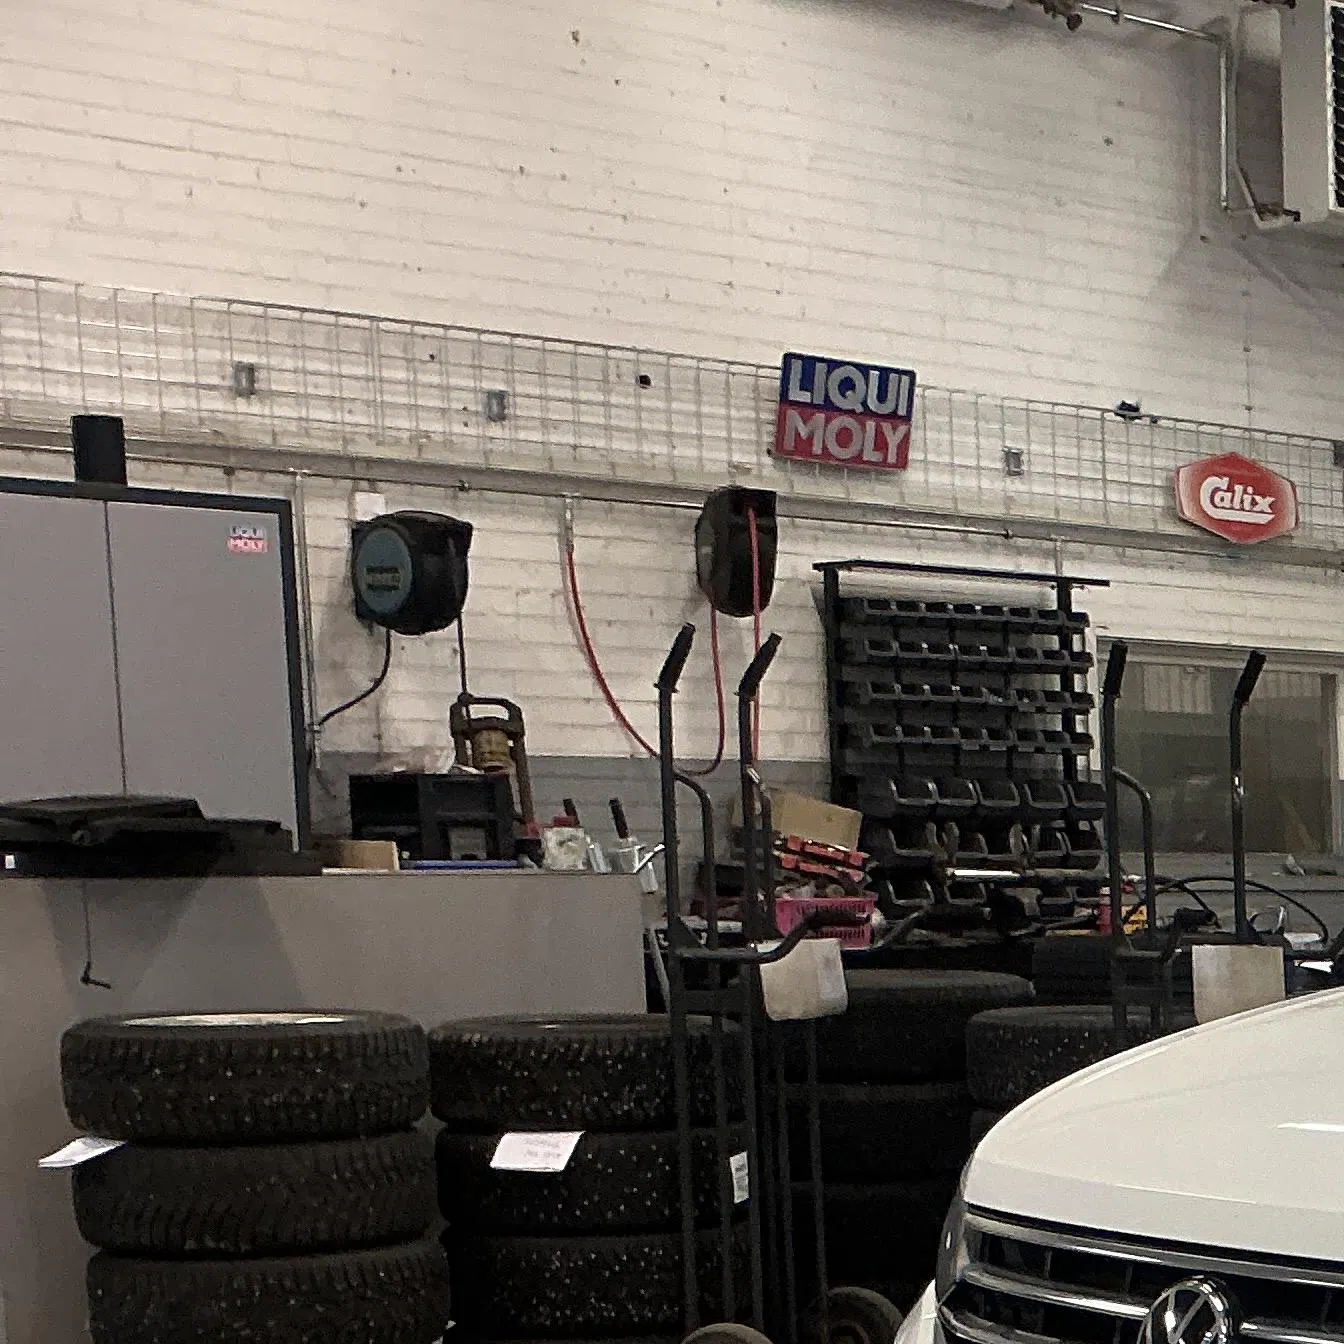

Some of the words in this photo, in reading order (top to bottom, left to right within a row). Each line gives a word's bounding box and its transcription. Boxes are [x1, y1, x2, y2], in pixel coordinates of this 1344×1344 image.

[788, 358, 911, 416] LIQUI
[782, 408, 912, 465] MOLY
[1200, 475, 1277, 525] Calix
